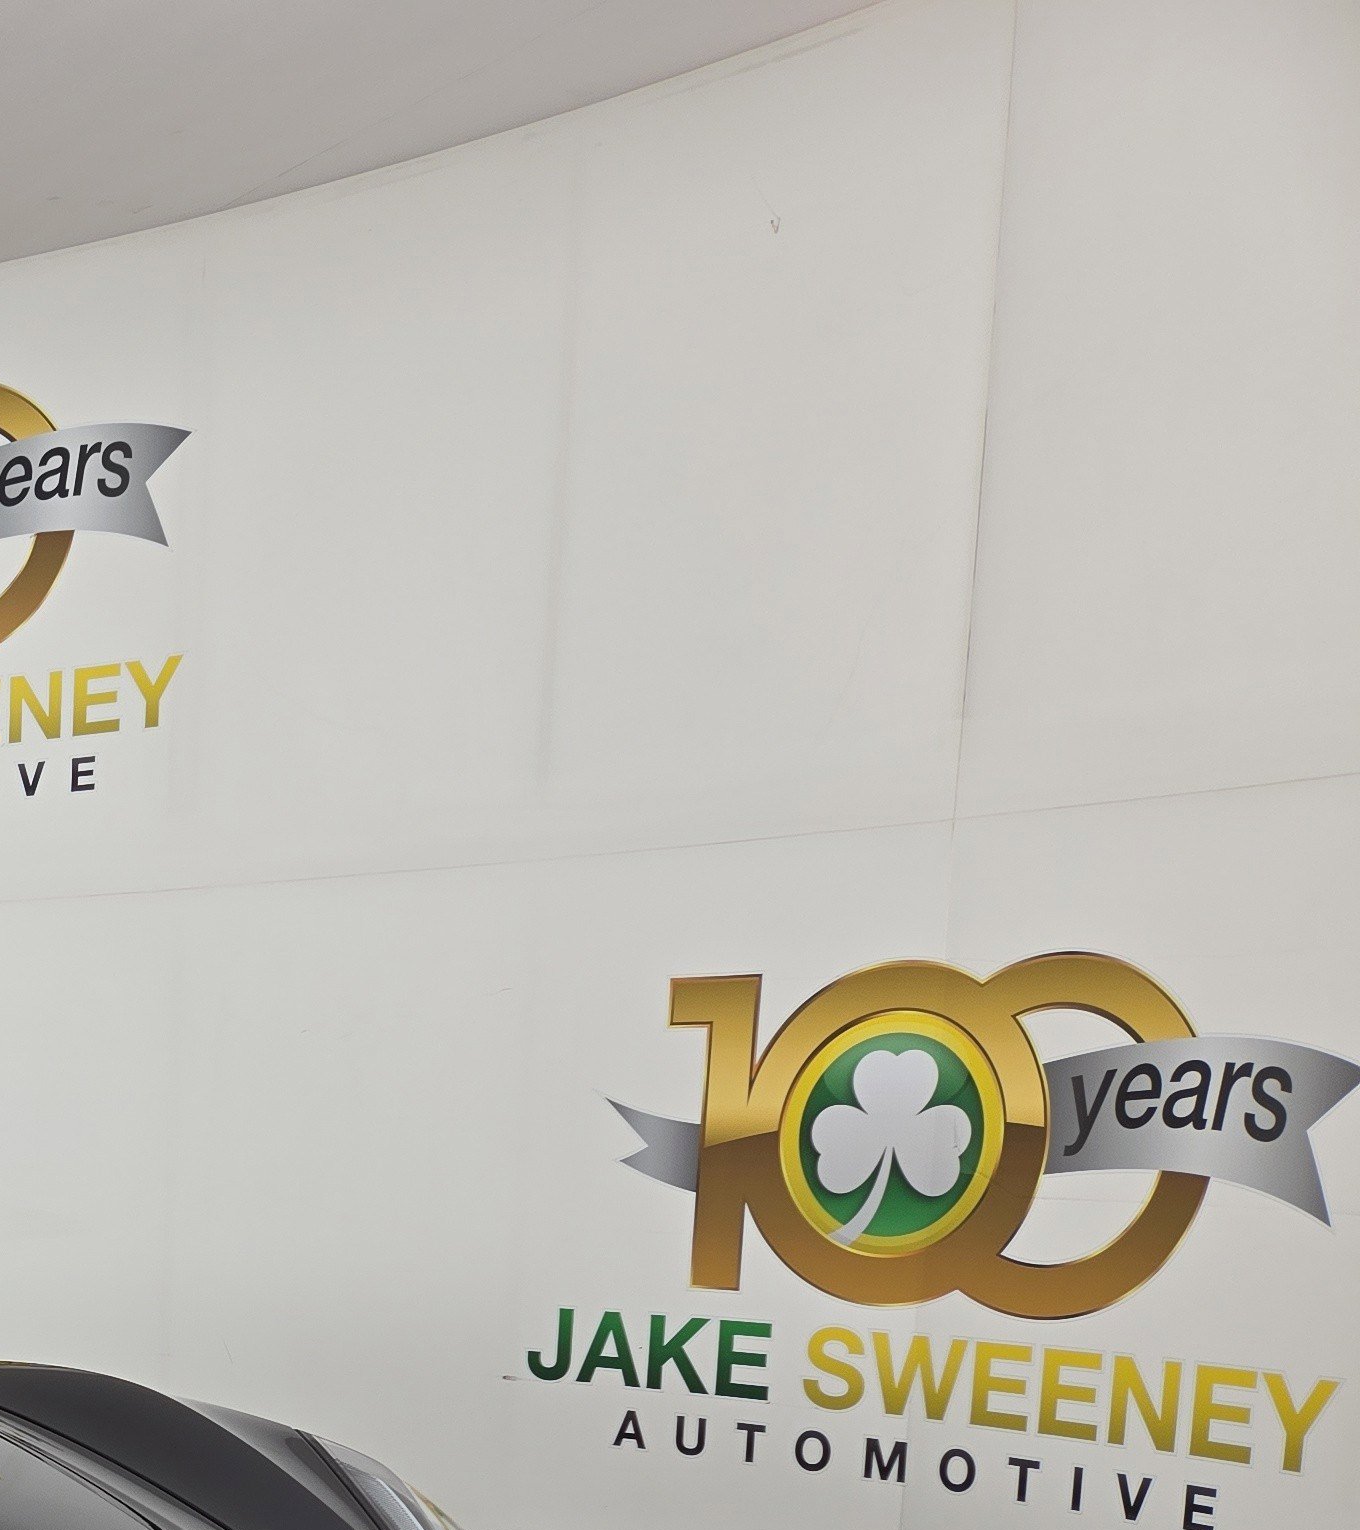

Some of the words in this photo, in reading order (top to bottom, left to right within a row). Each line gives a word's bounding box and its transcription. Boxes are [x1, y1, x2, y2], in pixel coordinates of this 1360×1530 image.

[1064, 1057, 1294, 1157] years
[527, 1308, 772, 1401] JAKE
[803, 1325, 1338, 1474] SWEENEY
